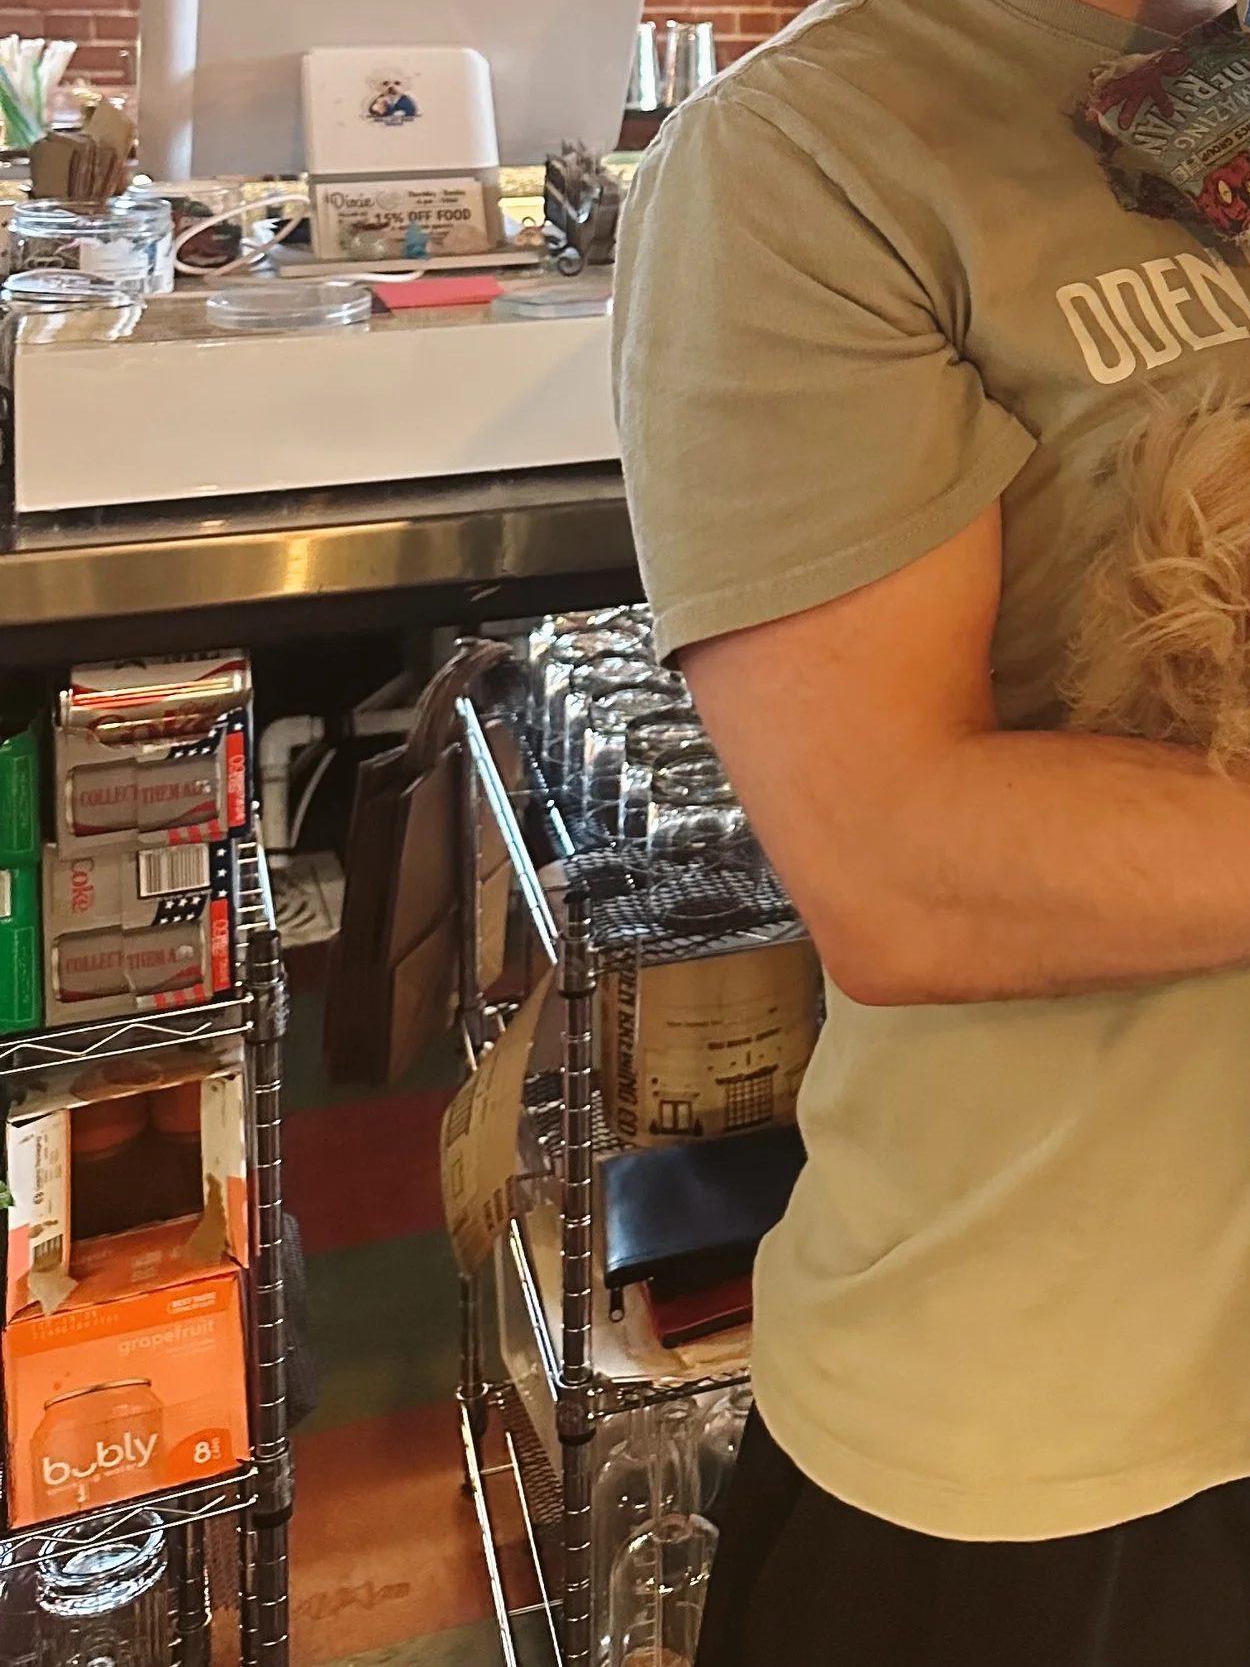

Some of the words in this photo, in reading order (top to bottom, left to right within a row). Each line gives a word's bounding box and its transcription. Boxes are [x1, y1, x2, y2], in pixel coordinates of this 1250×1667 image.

[1201, 137, 1234, 163] GROUP
[374, 211, 404, 225] 15%
[407, 209, 432, 223] OFF
[437, 207, 472, 222] FOOD
[80, 783, 138, 807] COLLECT
[141, 782, 181, 804] THEM
[70, 857, 95, 915] Coke
[65, 950, 123, 974] COLLECT
[126, 949, 165, 970] THEM
[118, 1319, 215, 1357] grapefruit
[42, 1432, 159, 1486] bubly
[193, 1441, 211, 1464] 8
